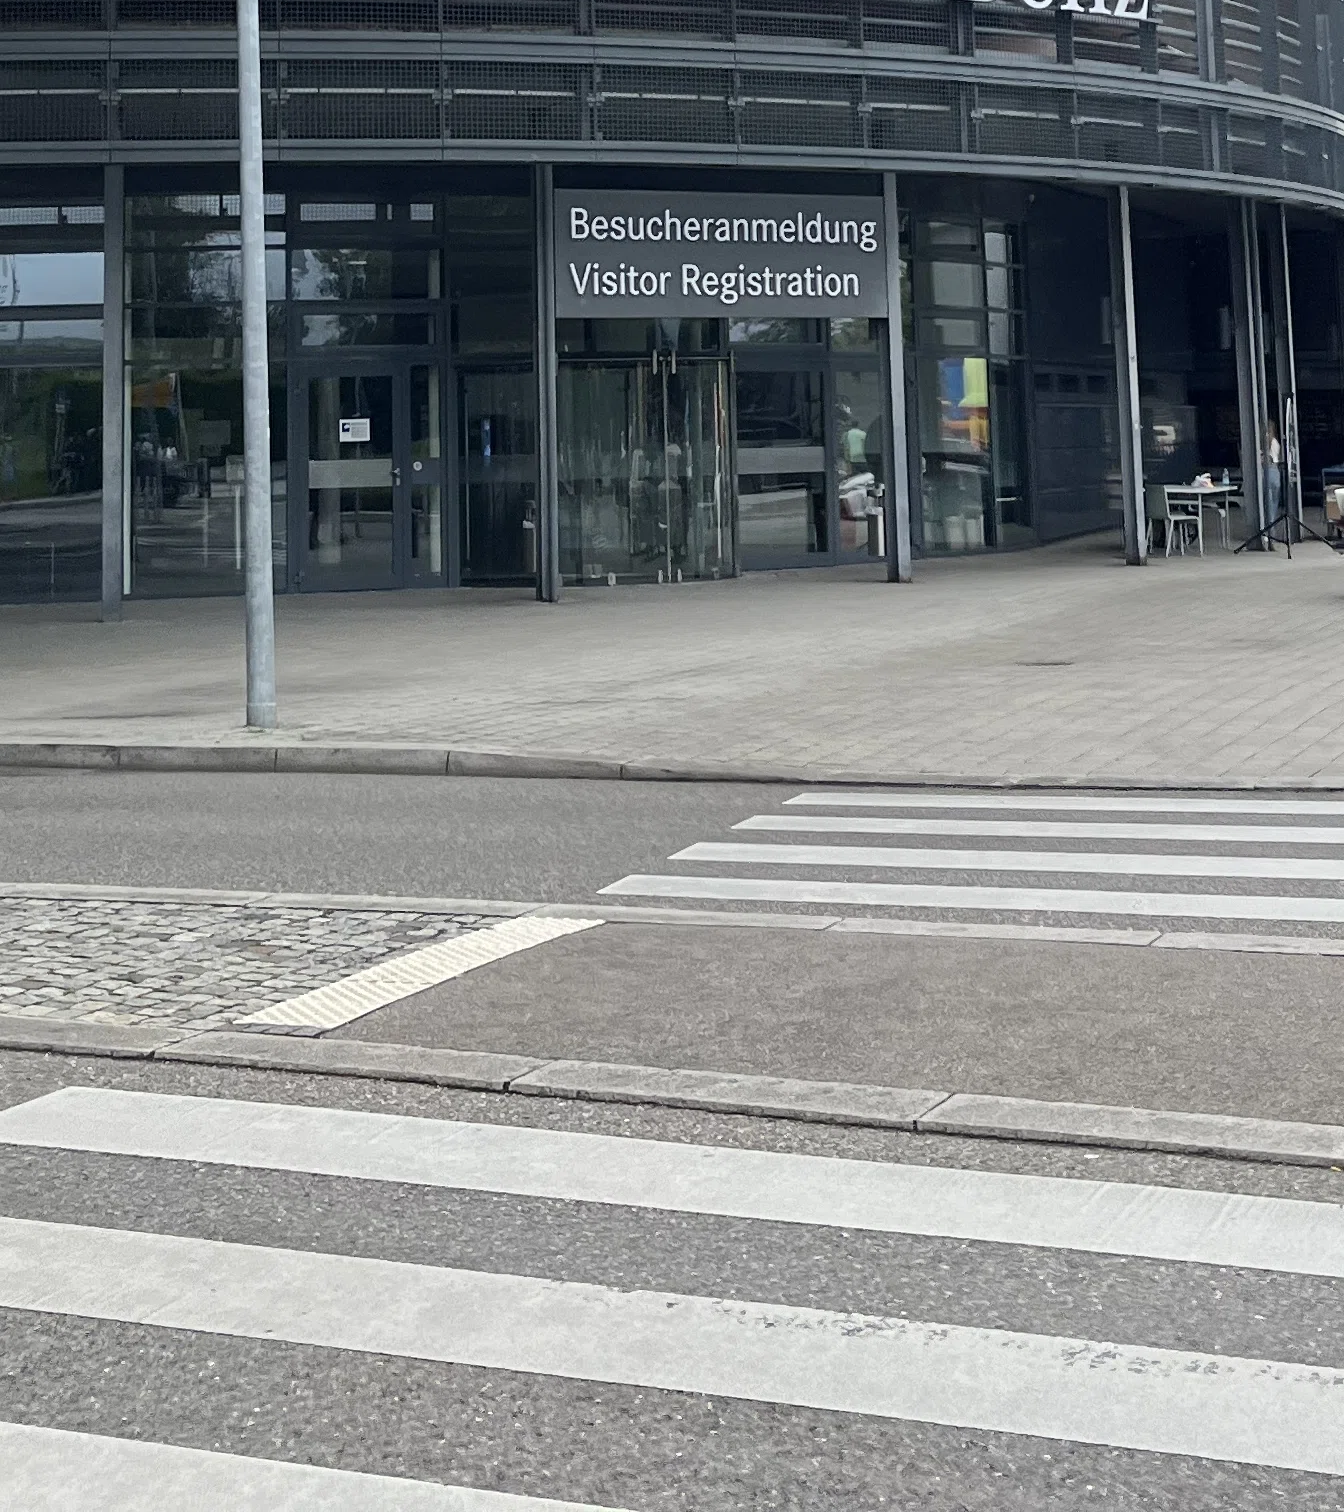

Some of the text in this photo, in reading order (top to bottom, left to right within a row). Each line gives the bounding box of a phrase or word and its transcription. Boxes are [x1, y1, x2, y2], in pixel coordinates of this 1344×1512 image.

[569, 207, 878, 253] Besucheranmeldung
[569, 262, 860, 305] Visitor Registration
